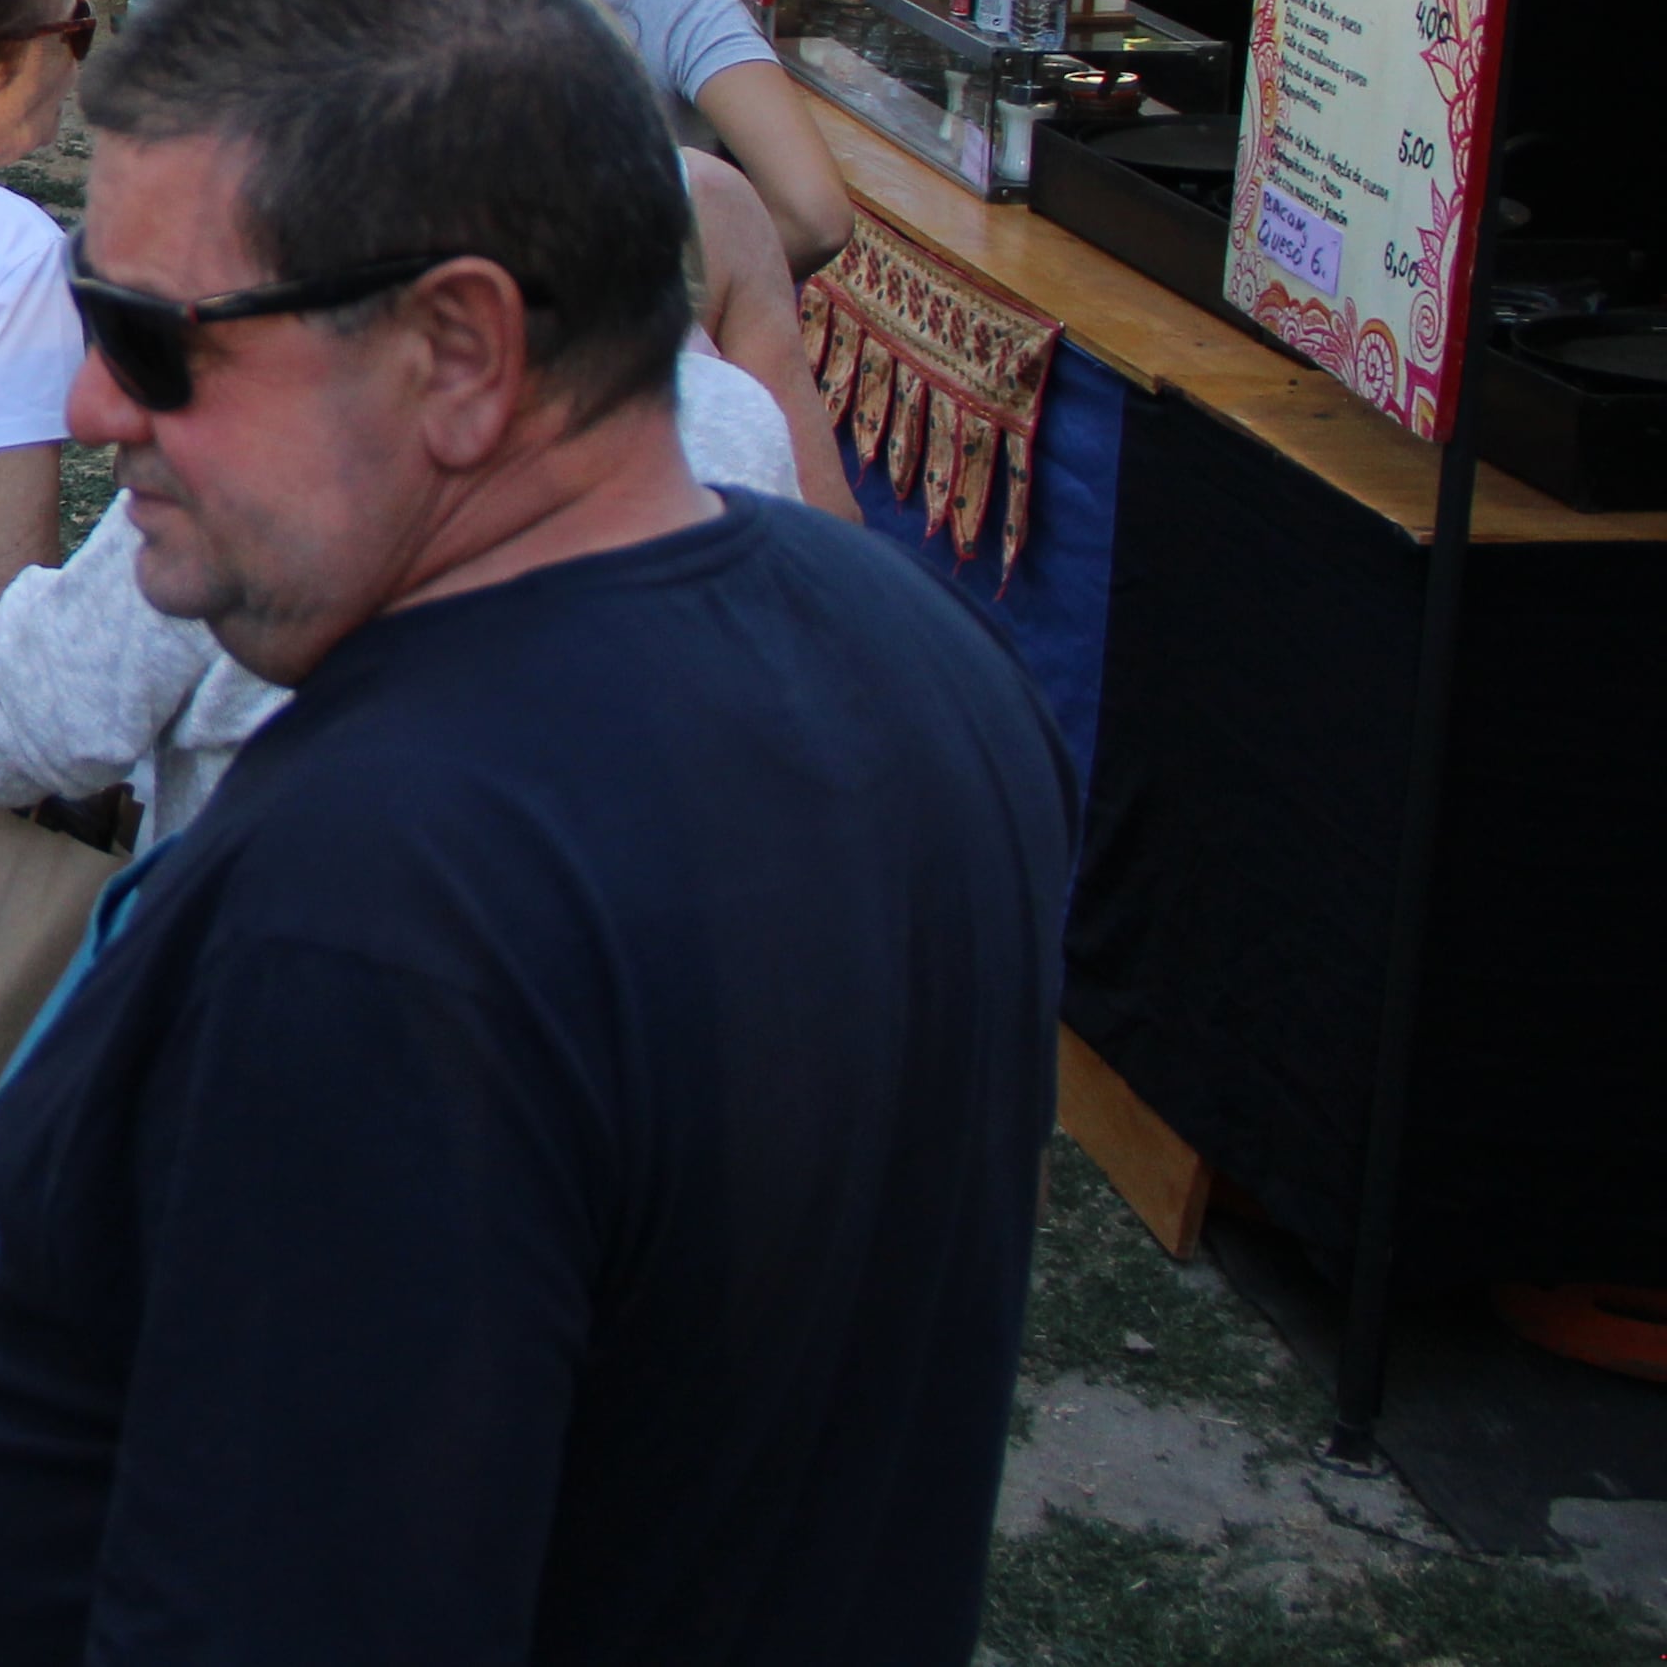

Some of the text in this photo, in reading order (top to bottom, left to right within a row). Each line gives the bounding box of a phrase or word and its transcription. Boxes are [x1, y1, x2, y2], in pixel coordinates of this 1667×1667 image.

[1415, 1, 1453, 43] 4,00
[1398, 127, 1435, 170] 5,00
[1263, 190, 1307, 233] BACON
[1257, 218, 1304, 266] QUESO
[1384, 240, 1419, 288] 6,00
